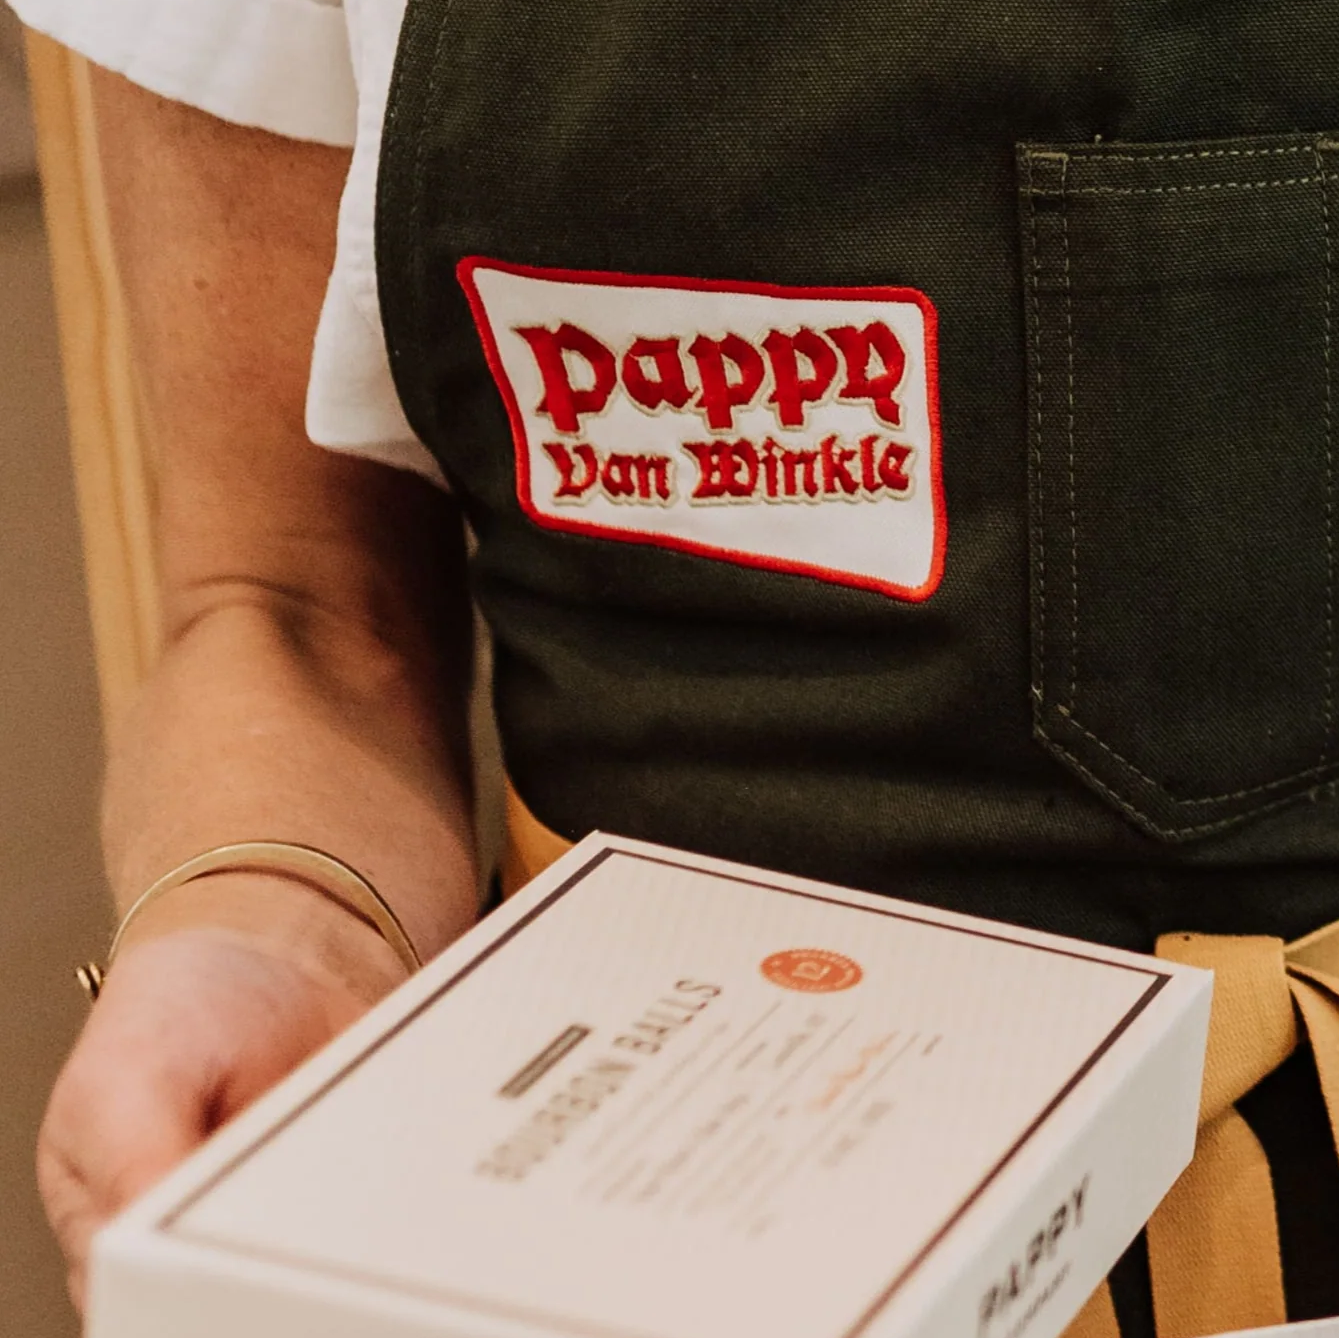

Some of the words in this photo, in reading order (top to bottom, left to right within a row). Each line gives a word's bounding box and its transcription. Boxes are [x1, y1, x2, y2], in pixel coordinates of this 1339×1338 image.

[542, 440, 673, 501] Van
[682, 434, 912, 499] Winkle
[611, 978, 723, 1056] BALLS
